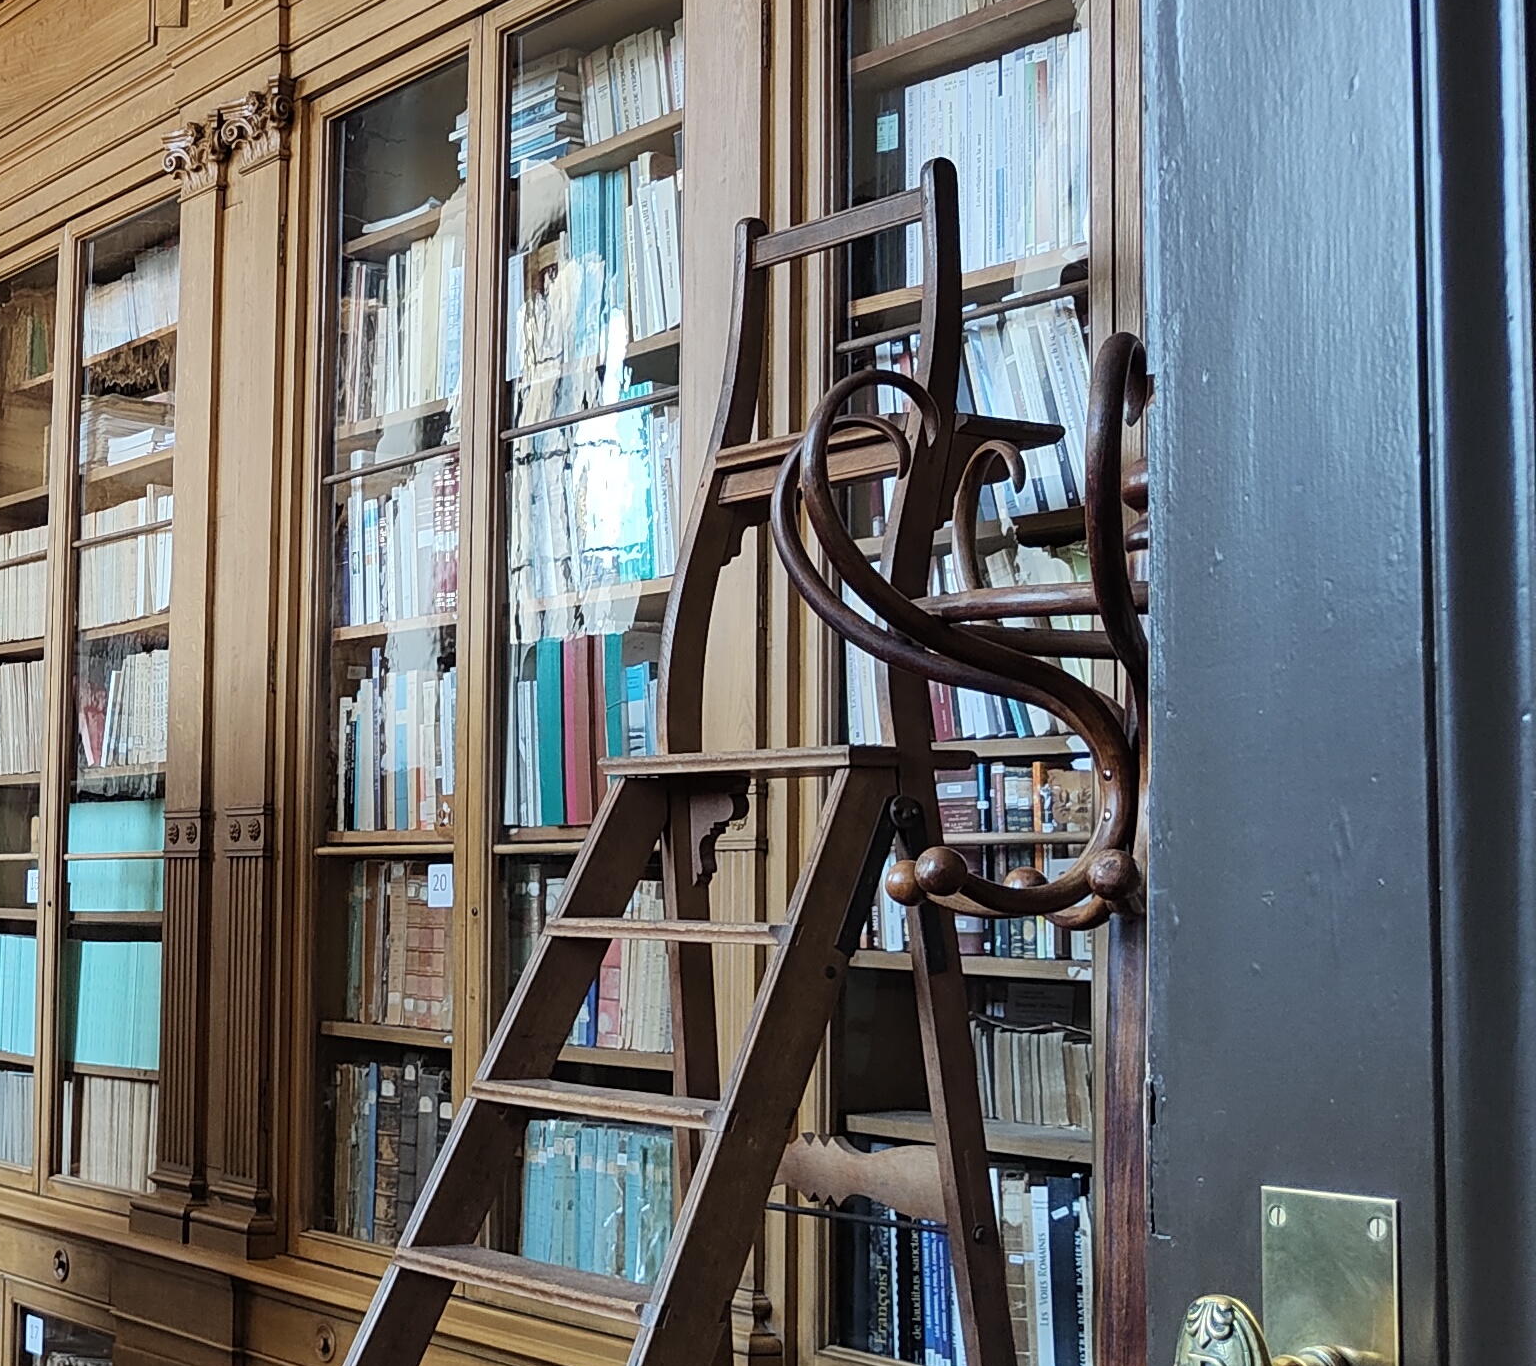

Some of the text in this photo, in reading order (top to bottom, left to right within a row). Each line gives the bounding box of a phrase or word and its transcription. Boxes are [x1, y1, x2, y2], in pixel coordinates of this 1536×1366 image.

[432, 873, 447, 892] 20
[910, 1274, 922, 1322] laudibus
[1036, 1232, 1050, 1327] LES VOIES ROMAINES
[30, 1324, 39, 1340] 17
[873, 1273, 891, 1346] François
